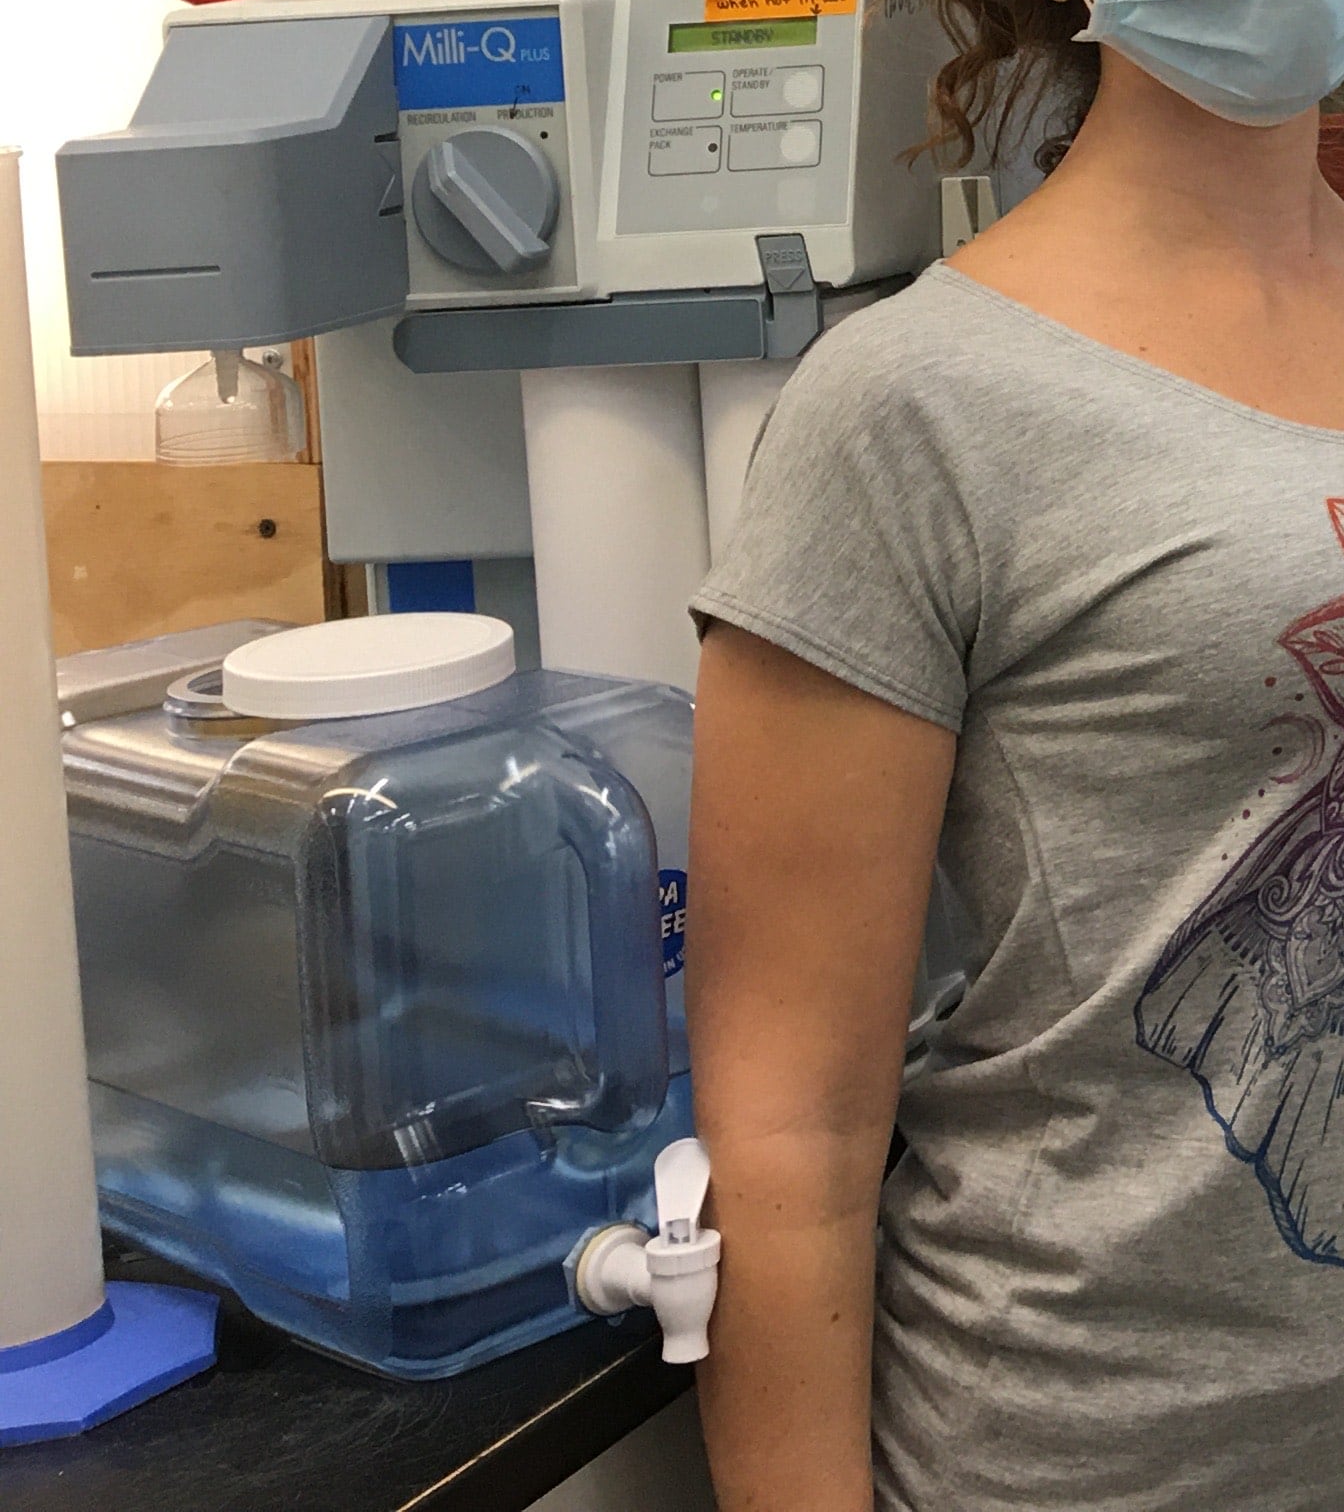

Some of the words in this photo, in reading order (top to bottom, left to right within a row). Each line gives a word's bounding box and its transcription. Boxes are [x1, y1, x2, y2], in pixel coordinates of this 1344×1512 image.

[711, 26, 775, 47] STANDBY
[403, 26, 517, 67] Milli-Q
[520, 47, 551, 62] PLUS
[653, 72, 683, 83] POWER
[407, 110, 477, 126] RECIRCULATION
[649, 126, 693, 138] EXCHANGE
[730, 121, 789, 134] TEMPERATURE
[648, 140, 671, 150] PACK
[764, 249, 803, 263] PRESS
